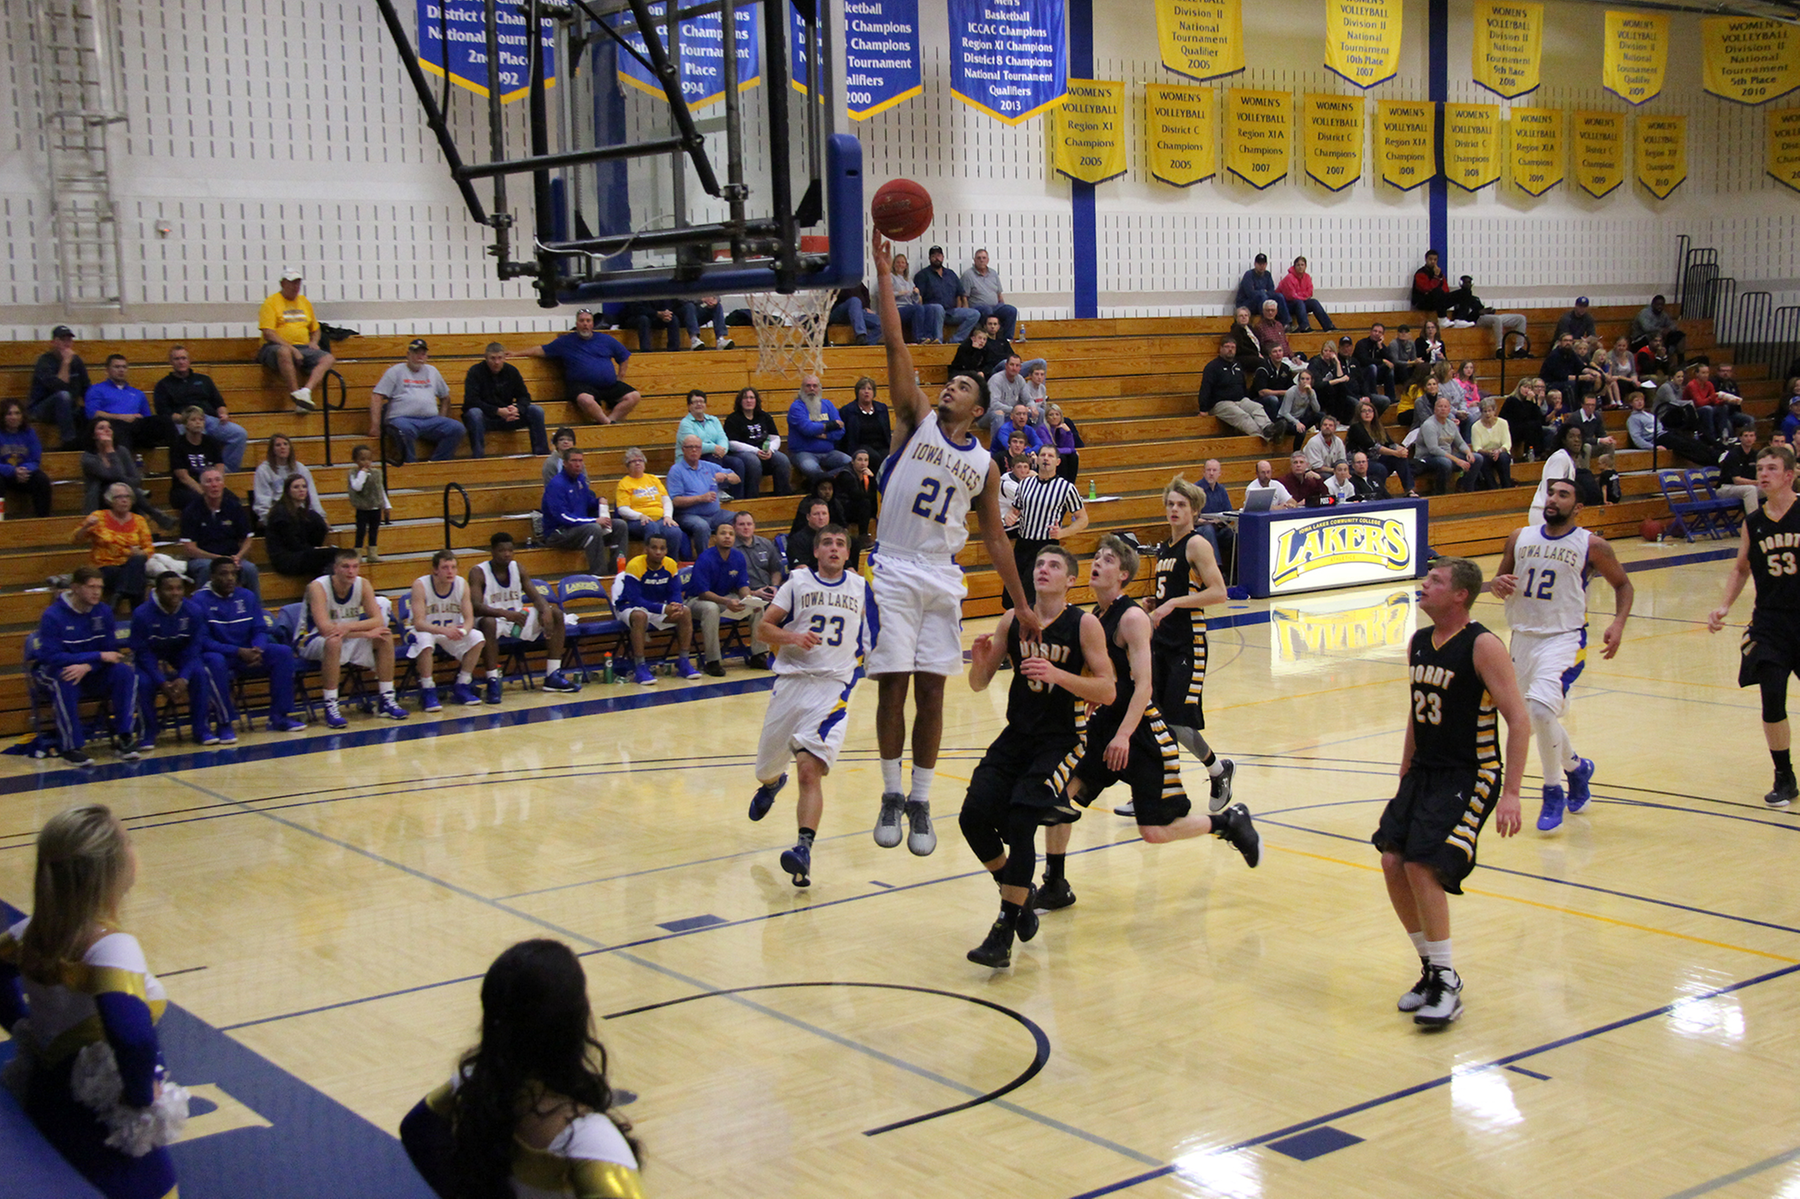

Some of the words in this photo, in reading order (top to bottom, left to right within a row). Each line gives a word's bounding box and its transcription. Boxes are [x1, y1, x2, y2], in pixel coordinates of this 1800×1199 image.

[985, 9, 1030, 22] Basketball
[1174, 6, 1211, 18] Division
[1217, 9, 1223, 19] II
[1340, 4, 1389, 18] VOLLEYBALL
[852, 20, 912, 35] Champions
[1179, 20, 1219, 33] National
[1344, 17, 1377, 28] Division
[1380, 21, 1386, 30] II
[1729, 20, 1783, 31] WOMEN'S
[968, 22, 997, 35] ICCAC
[999, 25, 1047, 39] Champions
[1347, 31, 1382, 42] National
[1172, 31, 1228, 44] Tournament
[1722, 31, 1788, 43] VOLLEYBALL
[851, 38, 910, 53] Champions
[962, 37, 993, 50] Region
[995, 40, 1004, 50] XI
[1006, 41, 1053, 53] Champions
[1181, 45, 1218, 57] Qualifier
[1340, 42, 1389, 54] Tournament
[1725, 44, 1772, 54] Division
[1777, 41, 1785, 50] II
[848, 55, 912, 69] Tournament
[963, 52, 995, 65] District
[996, 56, 1003, 65] 8
[1005, 55, 1053, 69] Champions
[1188, 59, 1210, 70] 2005
[1346, 55, 1363, 64] 10th
[1730, 53, 1779, 64] National
[684, 62, 717, 76] Place
[964, 68, 1000, 80] National
[1003, 71, 1053, 82] Tournament
[1722, 64, 1788, 75] Tournament
[1730, 77, 1747, 86] 5th
[1750, 76, 1777, 85] Place
[989, 85, 1032, 97] Qualifiers
[1067, 86, 1112, 98] WOMEN'S
[1159, 91, 1201, 102] WOMEN'S
[1742, 87, 1766, 96] 2010
[1000, 100, 1021, 111] 2013
[1240, 96, 1281, 107] WOMEN'S
[1316, 101, 1354, 111] WOMEN'S
[1062, 103, 1117, 114] VOLLEYBALL
[1155, 107, 1205, 119] VOLLEYBALL
[1389, 108, 1425, 117] WOMEN'S
[1237, 112, 1286, 123] VOLLEYBALL
[1312, 117, 1359, 127] VOLLEYBALL
[1068, 120, 1099, 132] Region
[1102, 122, 1113, 130] XI
[1161, 124, 1191, 134] District
[1193, 126, 1200, 135] C
[1384, 122, 1427, 132] VOLLEYBALL
[1238, 128, 1265, 140] Region
[1317, 132, 1344, 142] District
[1347, 133, 1352, 142] C
[1065, 137, 1114, 149] Champions
[1157, 141, 1203, 152] Champions
[1385, 137, 1410, 148] Region
[1239, 144, 1283, 156] Champions
[1314, 148, 1357, 159] Champions
[1080, 156, 1102, 166] 2005
[1386, 152, 1425, 162] Champions
[1170, 160, 1191, 169] 2005
[1251, 163, 1270, 172] 2007
[1326, 166, 1345, 175] 2007
[912, 442, 944, 466] IOWA
[945, 453, 981, 491] LAKES
[911, 477, 957, 525] 21
[1299, 526, 1312, 535] IOWA
[1273, 519, 1409, 578] LAKERS
[1518, 545, 1541, 560] IOWA
[1543, 545, 1578, 567] LAKES
[1767, 551, 1798, 577] 53
[1156, 575, 1167, 599] 5
[1523, 567, 1556, 601] 12
[801, 591, 824, 609] IOWA
[828, 592, 858, 614] LAKES
[810, 614, 845, 647] 23
[1413, 689, 1442, 725] 23
